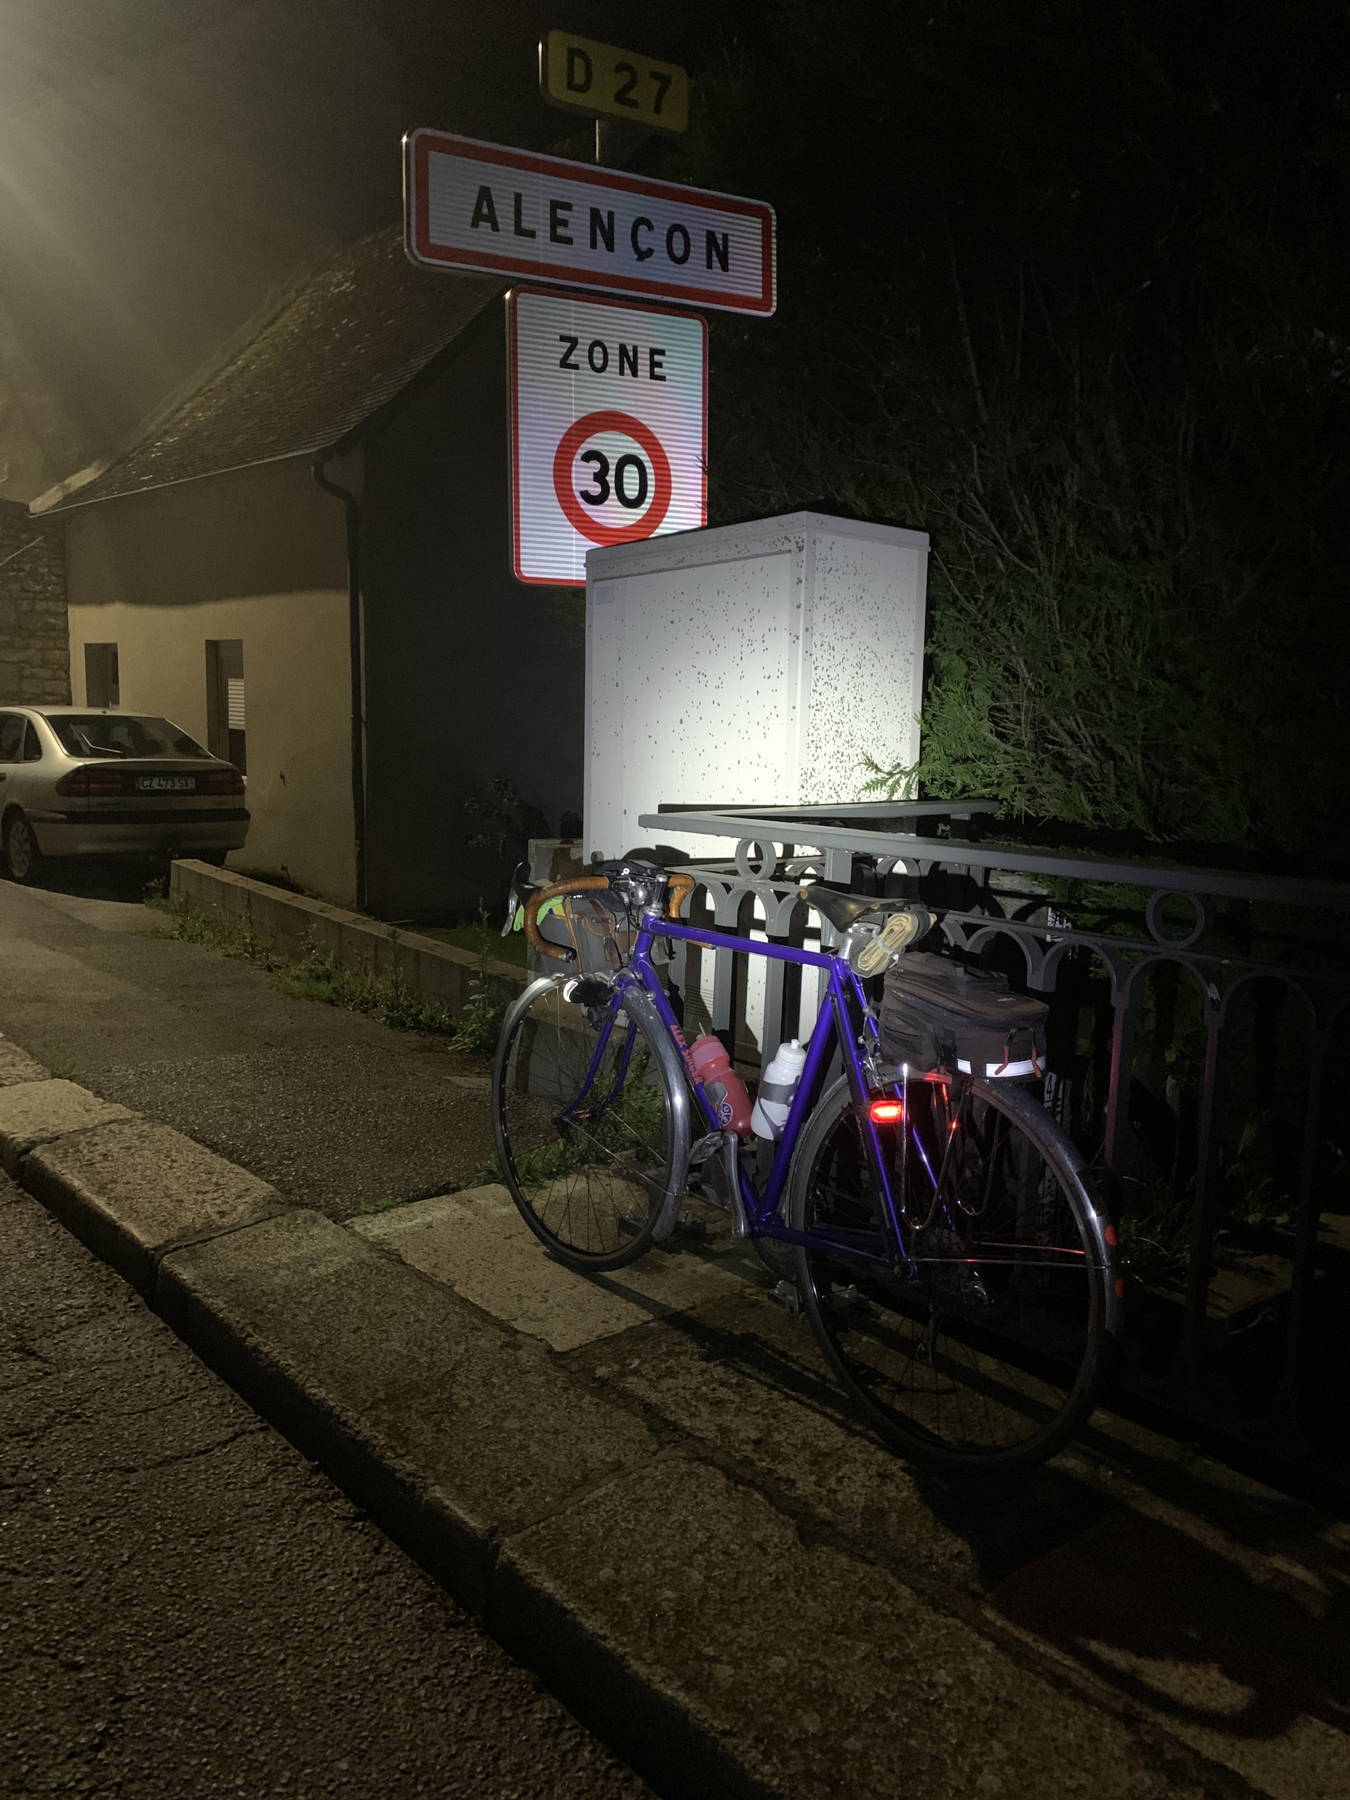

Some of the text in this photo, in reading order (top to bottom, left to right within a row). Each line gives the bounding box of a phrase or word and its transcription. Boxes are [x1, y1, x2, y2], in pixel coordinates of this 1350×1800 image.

[567, 47, 672, 114] D 27
[470, 185, 731, 273] ALENÇON
[559, 335, 666, 381] ZONE
[579, 450, 648, 509] 30
